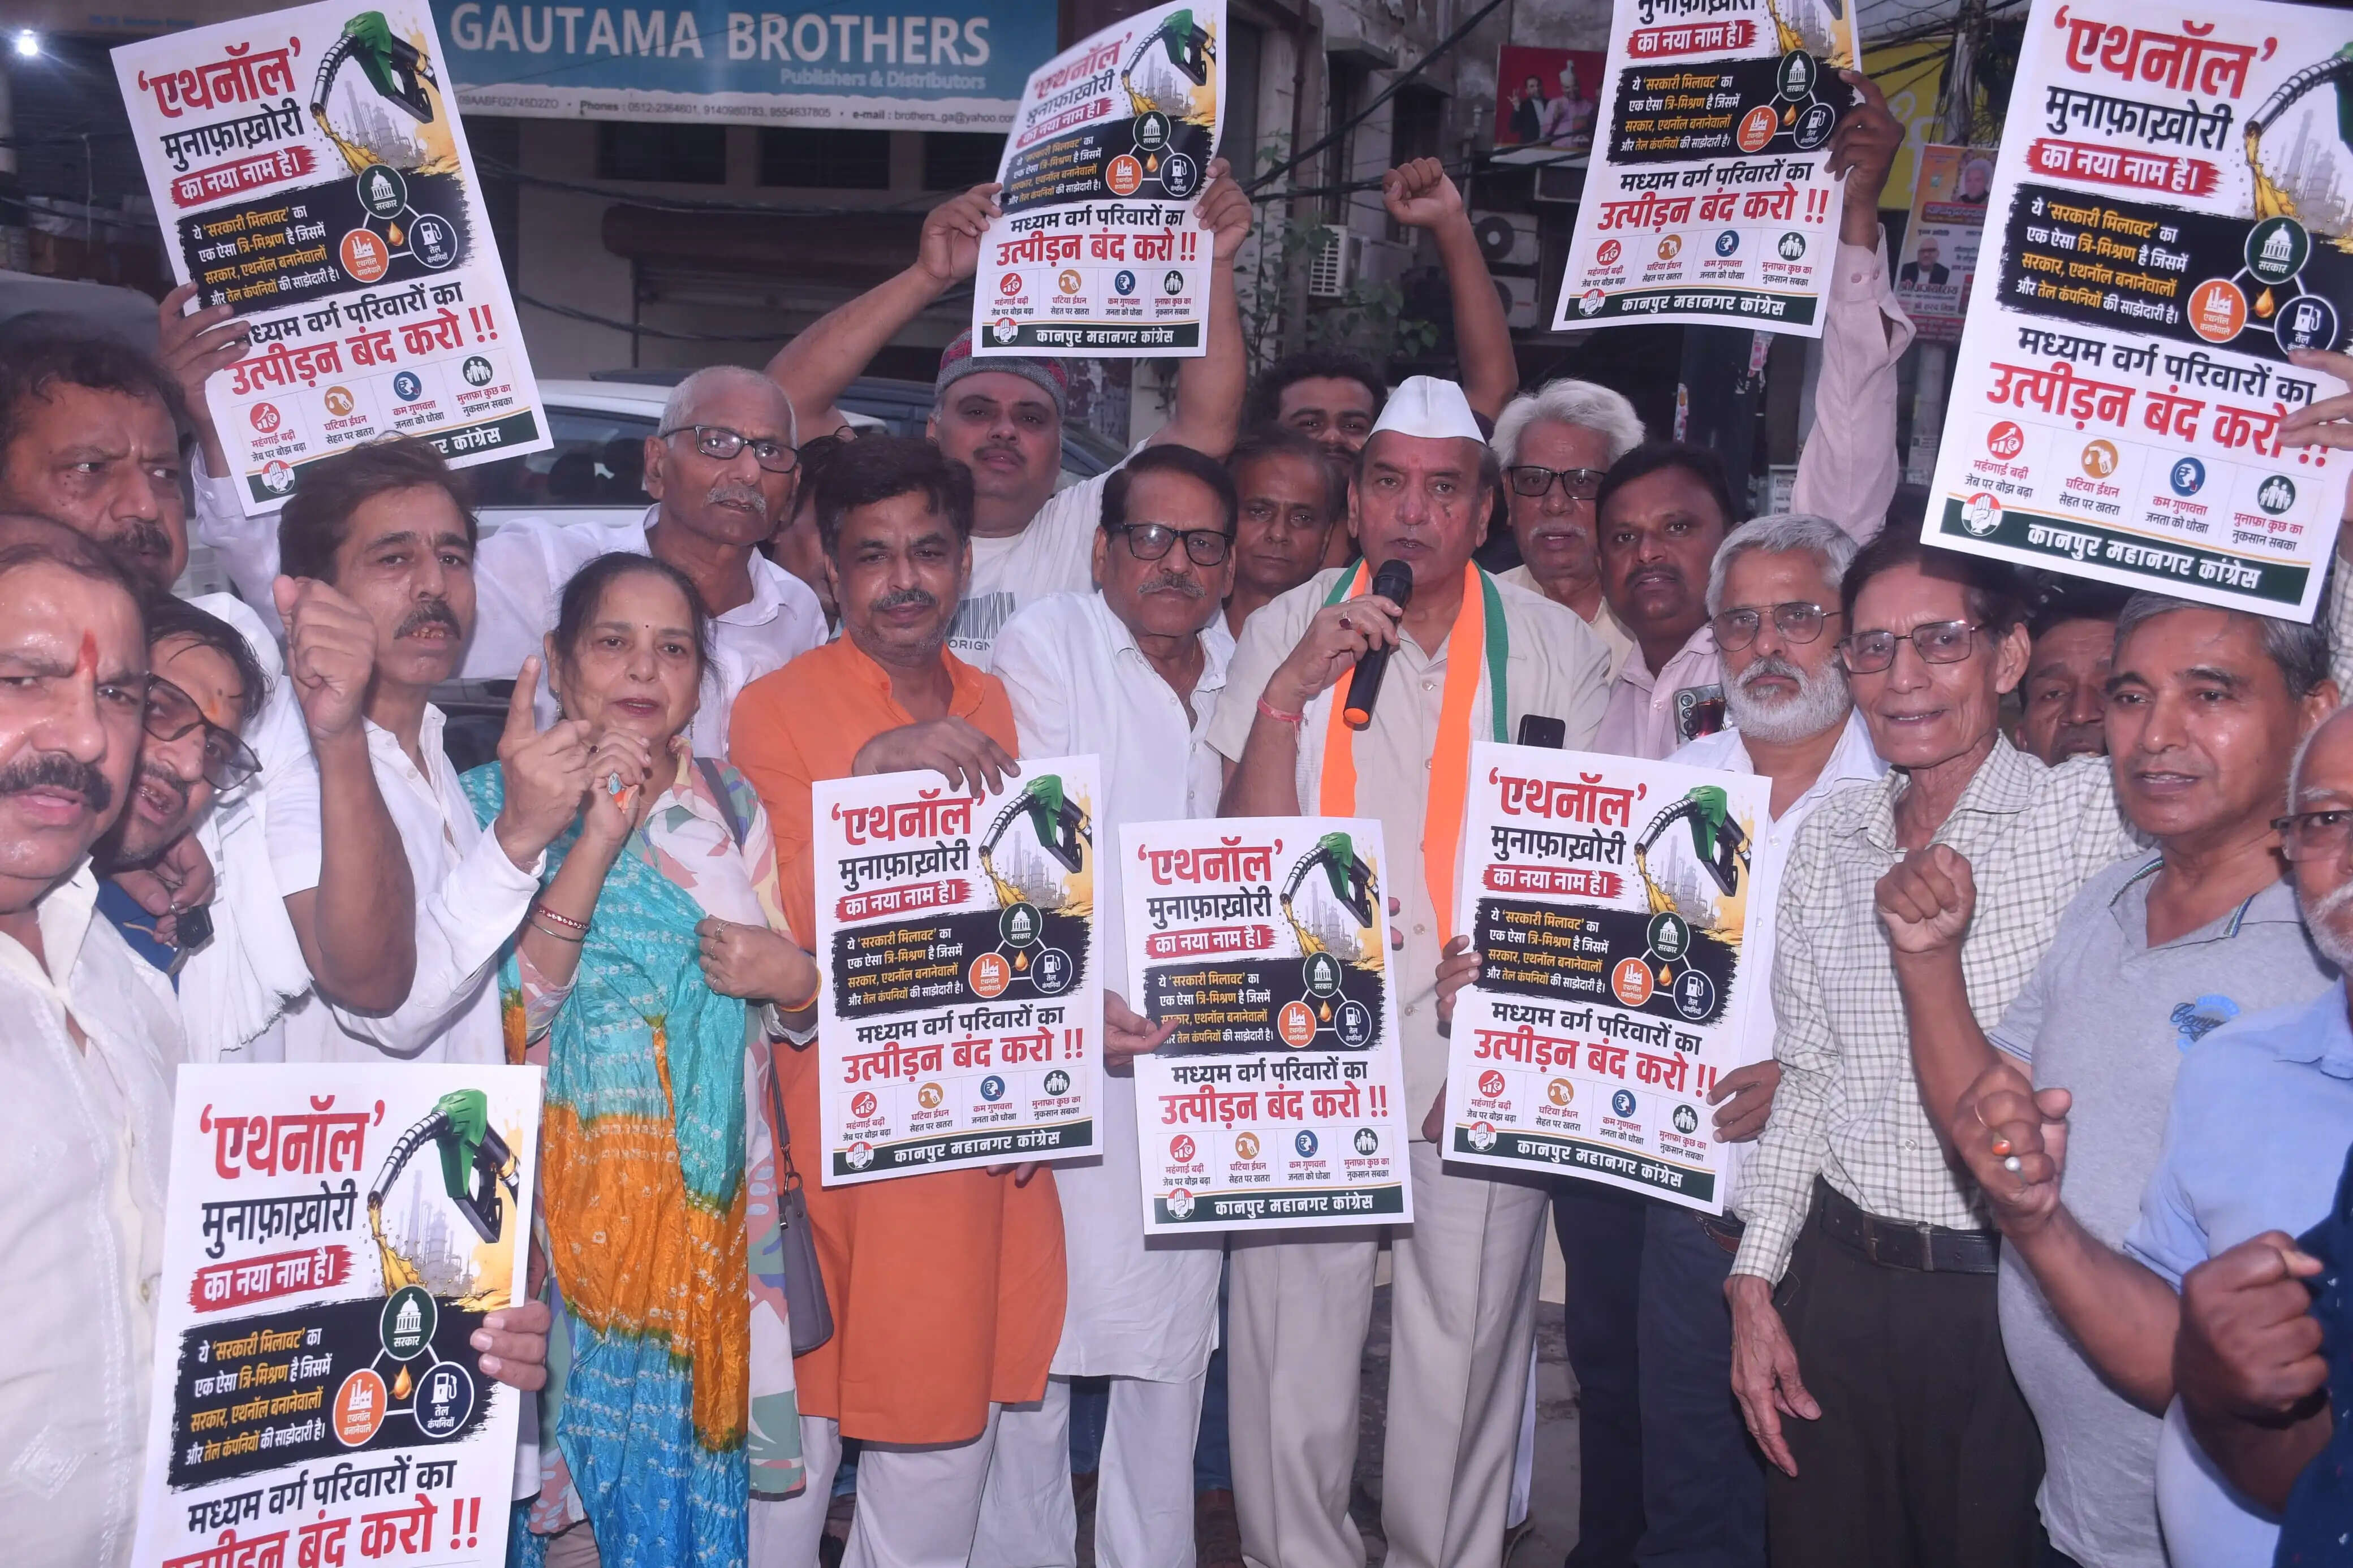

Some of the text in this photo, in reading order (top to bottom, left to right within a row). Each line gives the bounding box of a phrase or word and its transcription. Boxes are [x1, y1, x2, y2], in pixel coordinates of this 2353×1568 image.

[451, 3, 990, 66] GAUTAMA BROTHERS
[1637, 31, 1658, 52] का
[1662, 29, 1691, 50] नया
[1695, 27, 1723, 47] नाम
[781, 68, 986, 90] Publishers & Distributors
[1632, 76, 1641, 90] ये
[1721, 76, 1733, 87] का
[580, 100, 619, 112] Phones
[852, 110, 885, 120] e-mail
[1621, 158, 1815, 192] मध्यम वर्ग परिवारों का
[1597, 192, 1696, 233] उत्पीड़न
[1699, 187, 1740, 221] बंद
[1743, 182, 1798, 219] करो
[2068, 262, 2113, 284] एथनॉल
[303, 301, 341, 331] वर्ग
[343, 283, 427, 327] परिवारों
[429, 281, 463, 305] का
[1622, 295, 1786, 315] कानपुर महानगर कांग्रेस
[223, 340, 343, 394] उत्पीड़न
[345, 326, 397, 366] बंद
[398, 307, 463, 355] करो
[1986, 361, 2135, 429] उत्पीड़न
[2143, 384, 2206, 441] बंद
[451, 427, 501, 450] कांग्रेस
[2027, 522, 2262, 590] कानपुर महानगर कांग्रेस
[1493, 868, 1516, 886] का
[1519, 864, 1551, 888] नया
[1554, 872, 1586, 891] नाम
[844, 897, 867, 915] का
[869, 890, 900, 910] नया
[903, 886, 934, 905] नाम
[847, 957, 863, 969] एक
[864, 953, 882, 966] ऐसा
[928, 945, 934, 960] है
[936, 943, 963, 957] जिसमें
[1486, 965, 1501, 979] और
[1502, 967, 1516, 980] तेल
[1517, 970, 1549, 984] कंपनियों
[1550, 973, 1561, 986] की
[1562, 975, 1594, 991] साझेदारी
[842, 1042, 944, 1083] उत्पीड़न
[951, 1033, 993, 1068] बंद
[999, 1026, 1054, 1063] करो
[1171, 1056, 1368, 1085] मध्यम वर्ग परिवारों का
[1159, 1085, 1259, 1129] उत्पीड़न
[1265, 1083, 1304, 1120] बंद
[1311, 1080, 1360, 1118] करो
[894, 1129, 1061, 1161] कानपुर महानगर कांग्रेस
[1518, 1140, 1683, 1187] कानपुर महानगर कांग्रेस
[1214, 1191, 1373, 1217] कानपुर महानगर कांग्रेस
[204, 1269, 232, 1301] का
[237, 1260, 272, 1294] नया
[276, 1256, 311, 1287] नाम
[187, 1455, 458, 1534] मध्यम वर्ग परिवारों का
[298, 1509, 352, 1567] बंद
[360, 1493, 438, 1558] करो
